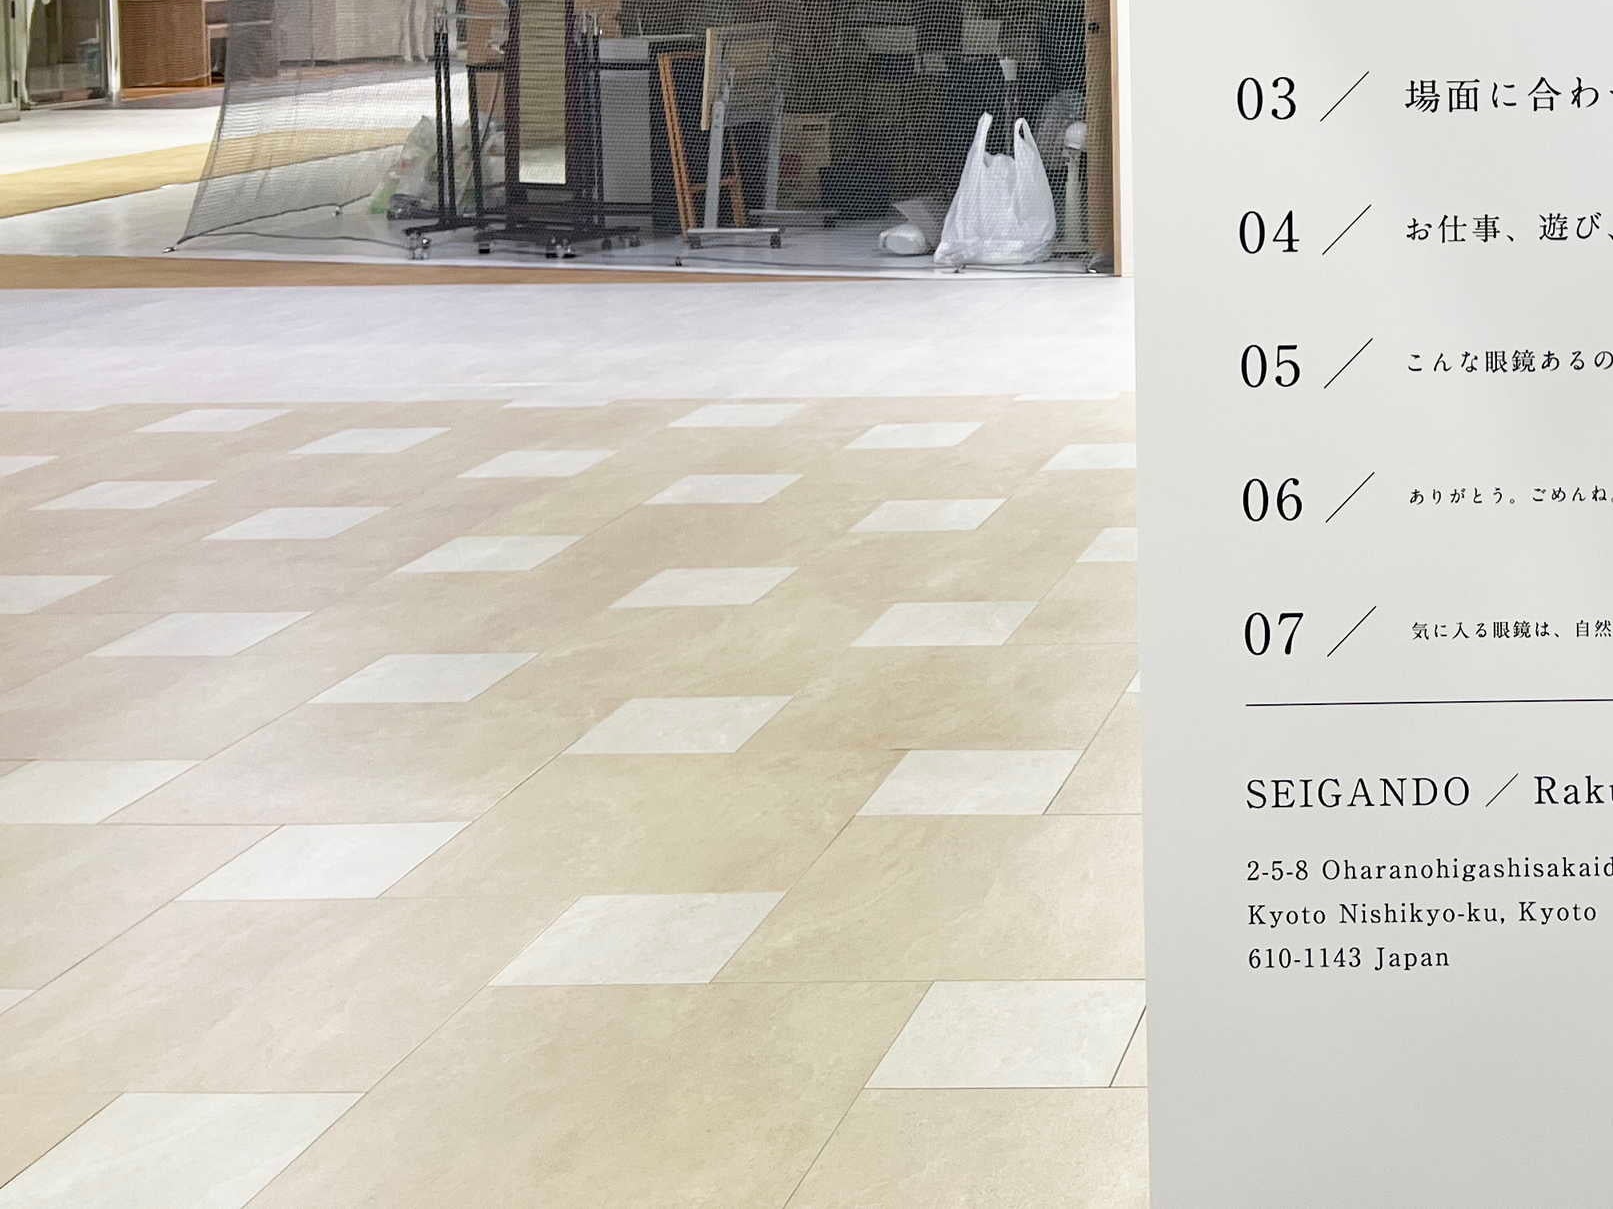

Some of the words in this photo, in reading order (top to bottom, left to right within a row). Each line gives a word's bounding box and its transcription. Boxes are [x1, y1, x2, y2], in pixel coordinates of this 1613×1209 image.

[1236, 76, 1297, 121] 03
[1238, 209, 1301, 255] 04
[1240, 344, 1301, 389] 05
[1242, 477, 1303, 523] 06
[1244, 611, 1304, 657] 07
[1246, 776, 1470, 810] SEIGANDO
[1246, 859, 1309, 882] 2-5-8
[1247, 904, 1326, 929] Kyoto
[1338, 901, 1505, 927] Nishikyo-ku,
[1517, 901, 1597, 926] Kyoto
[1248, 946, 1362, 970] 610-1143
[1374, 946, 1450, 972] Japan
